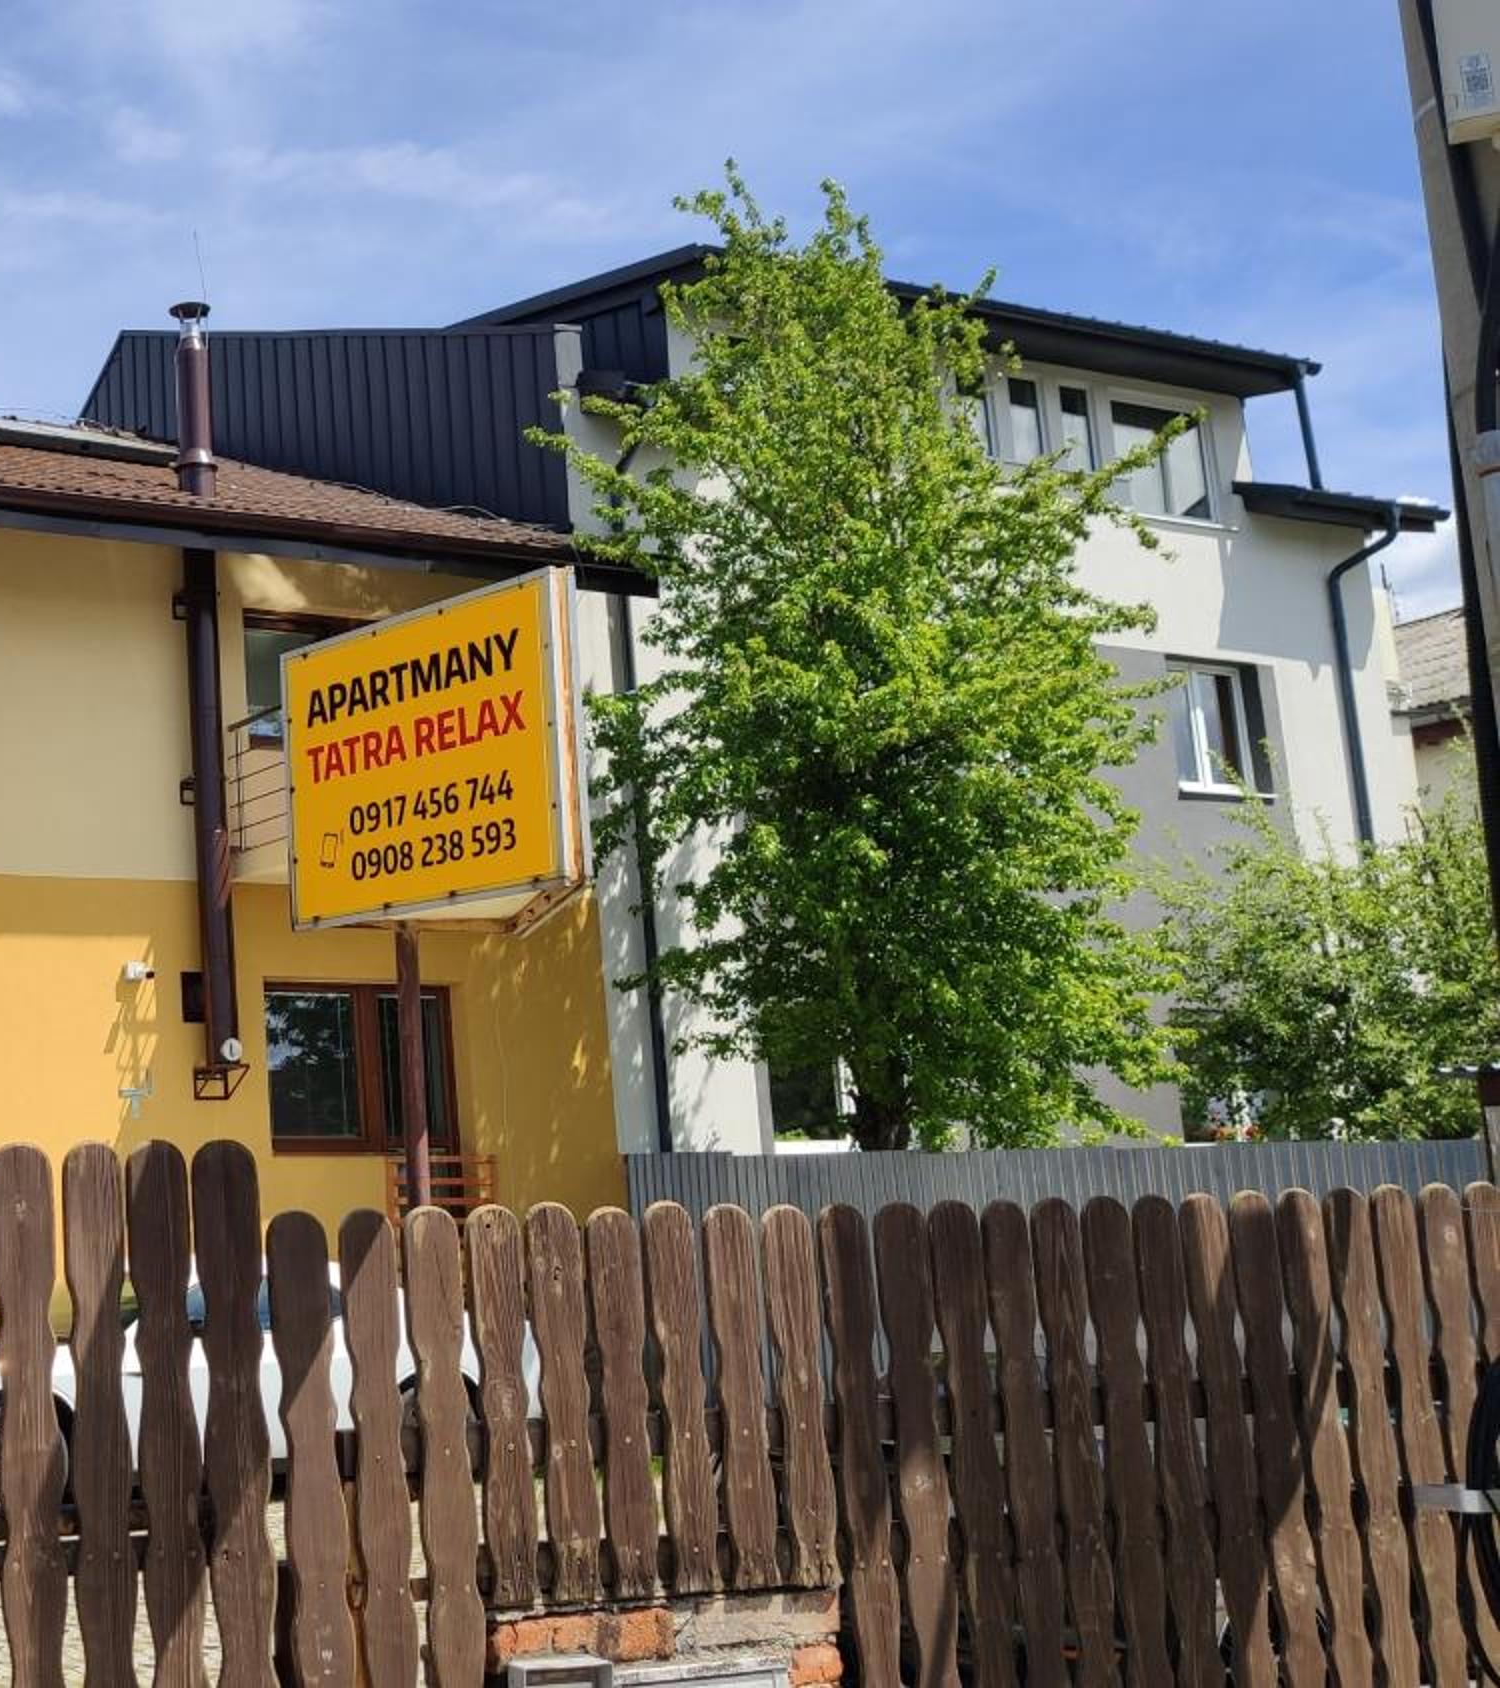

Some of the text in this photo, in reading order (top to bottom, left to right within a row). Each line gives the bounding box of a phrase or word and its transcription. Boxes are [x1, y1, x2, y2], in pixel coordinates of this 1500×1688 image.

[307, 628, 519, 728] APARTMANY
[307, 690, 526, 784] TATRA RELAX
[349, 769, 513, 835] 0917 456 744
[351, 818, 516, 880] 0908 238 593
